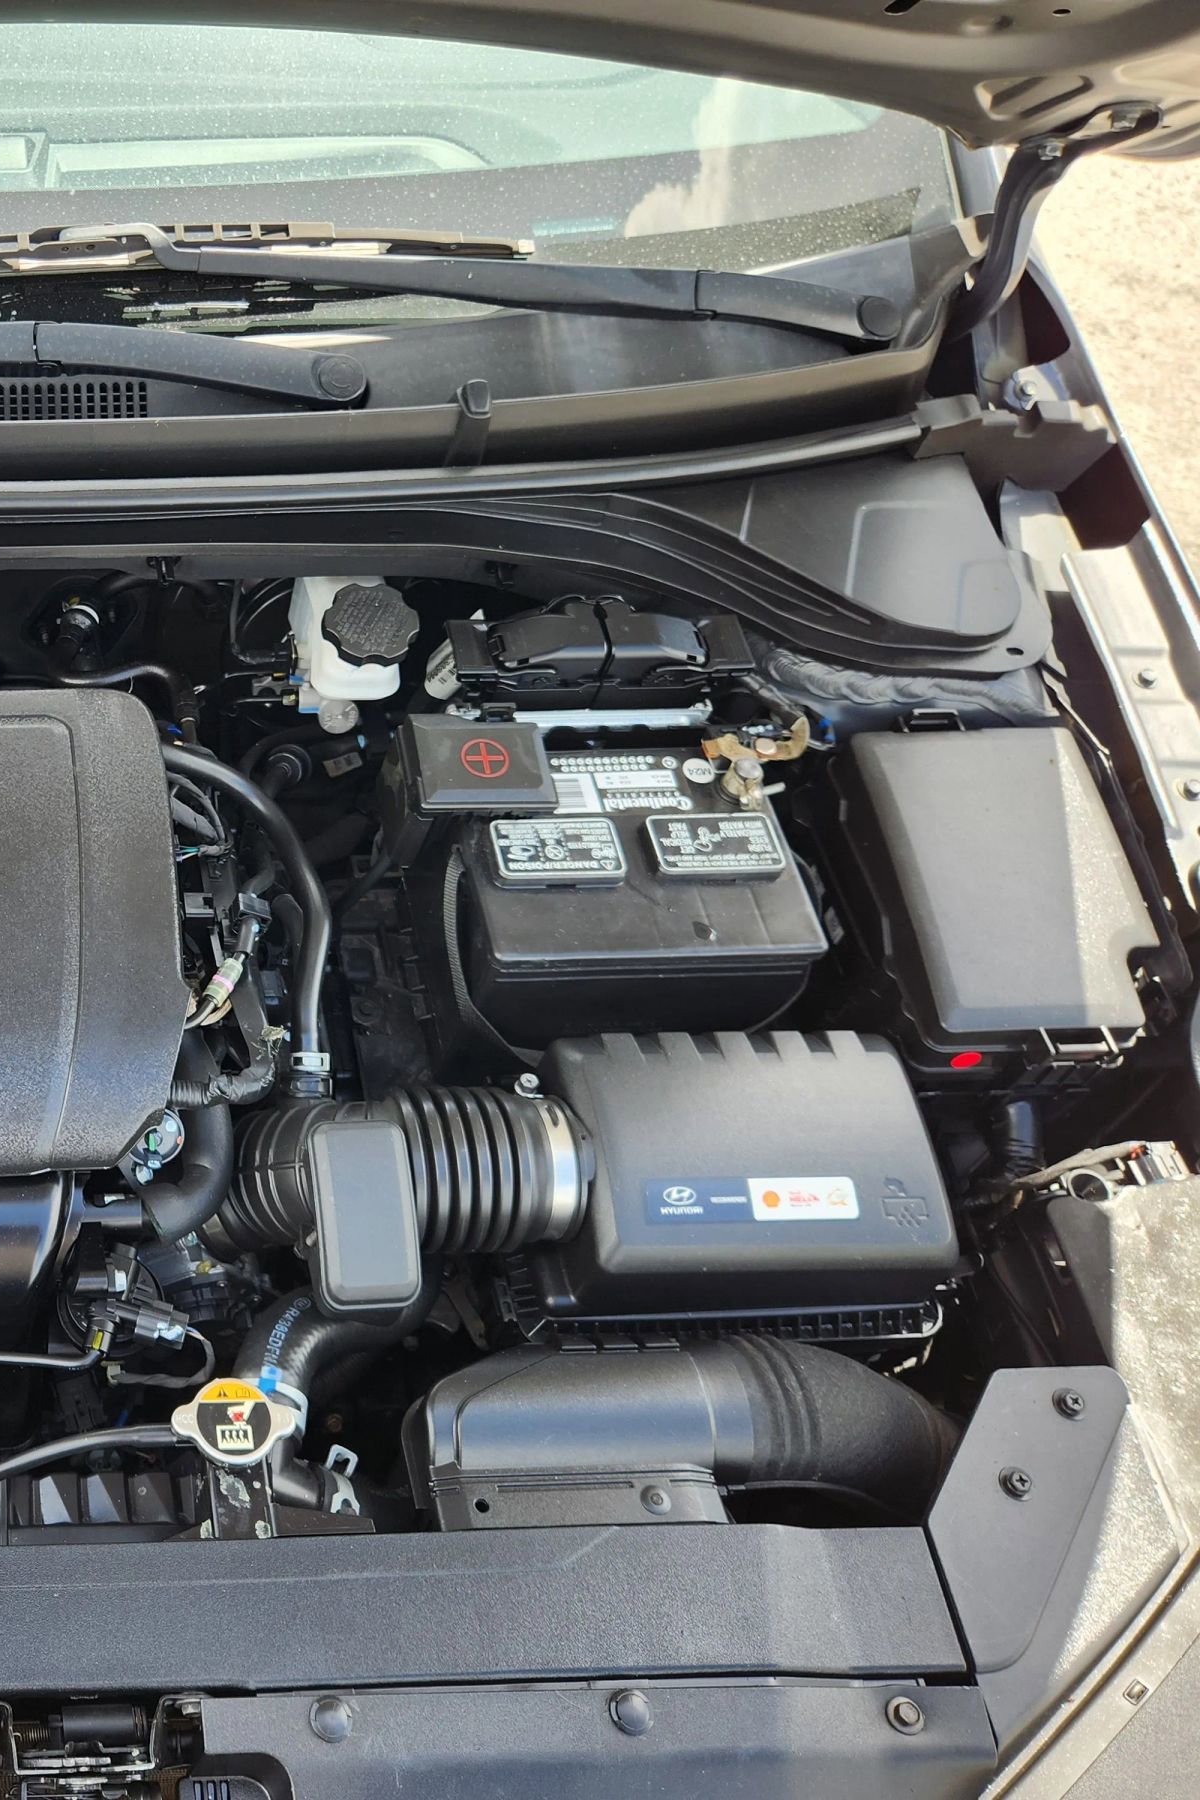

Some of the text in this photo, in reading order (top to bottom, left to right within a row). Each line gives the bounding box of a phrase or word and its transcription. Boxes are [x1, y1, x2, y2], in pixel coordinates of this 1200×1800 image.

[687, 767, 712, 776] M24
[602, 796, 694, 812] Continental
[508, 860, 601, 870] DANGER/POISON
[660, 1206, 704, 1216] HYUNDAI
